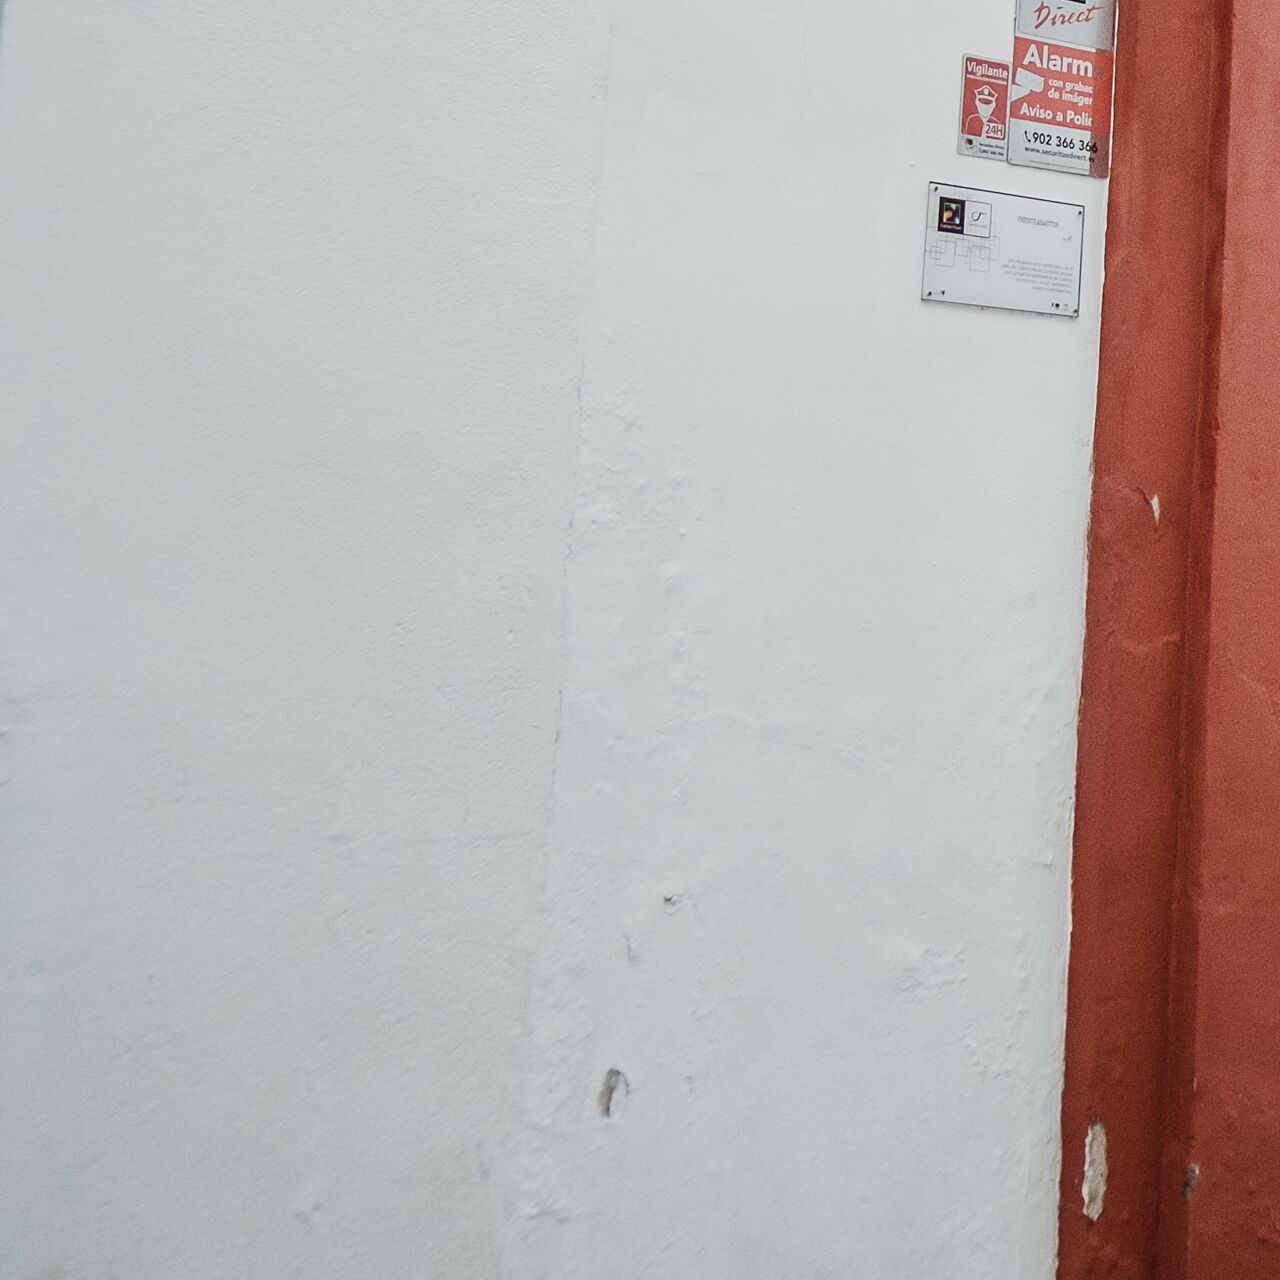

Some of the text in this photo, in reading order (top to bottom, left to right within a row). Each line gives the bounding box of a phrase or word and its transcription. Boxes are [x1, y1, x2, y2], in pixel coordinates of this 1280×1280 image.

[1033, 1, 1104, 30] Direct
[967, 61, 1008, 78] Vigilante
[1022, 44, 1103, 79] Alarm
[1048, 78, 1063, 88] con
[1047, 87, 1060, 99] de
[1020, 102, 1053, 120] Aviso
[1056, 111, 1063, 122] a
[986, 123, 1003, 137] 24H
[1032, 131, 1098, 154] 902 366 366
